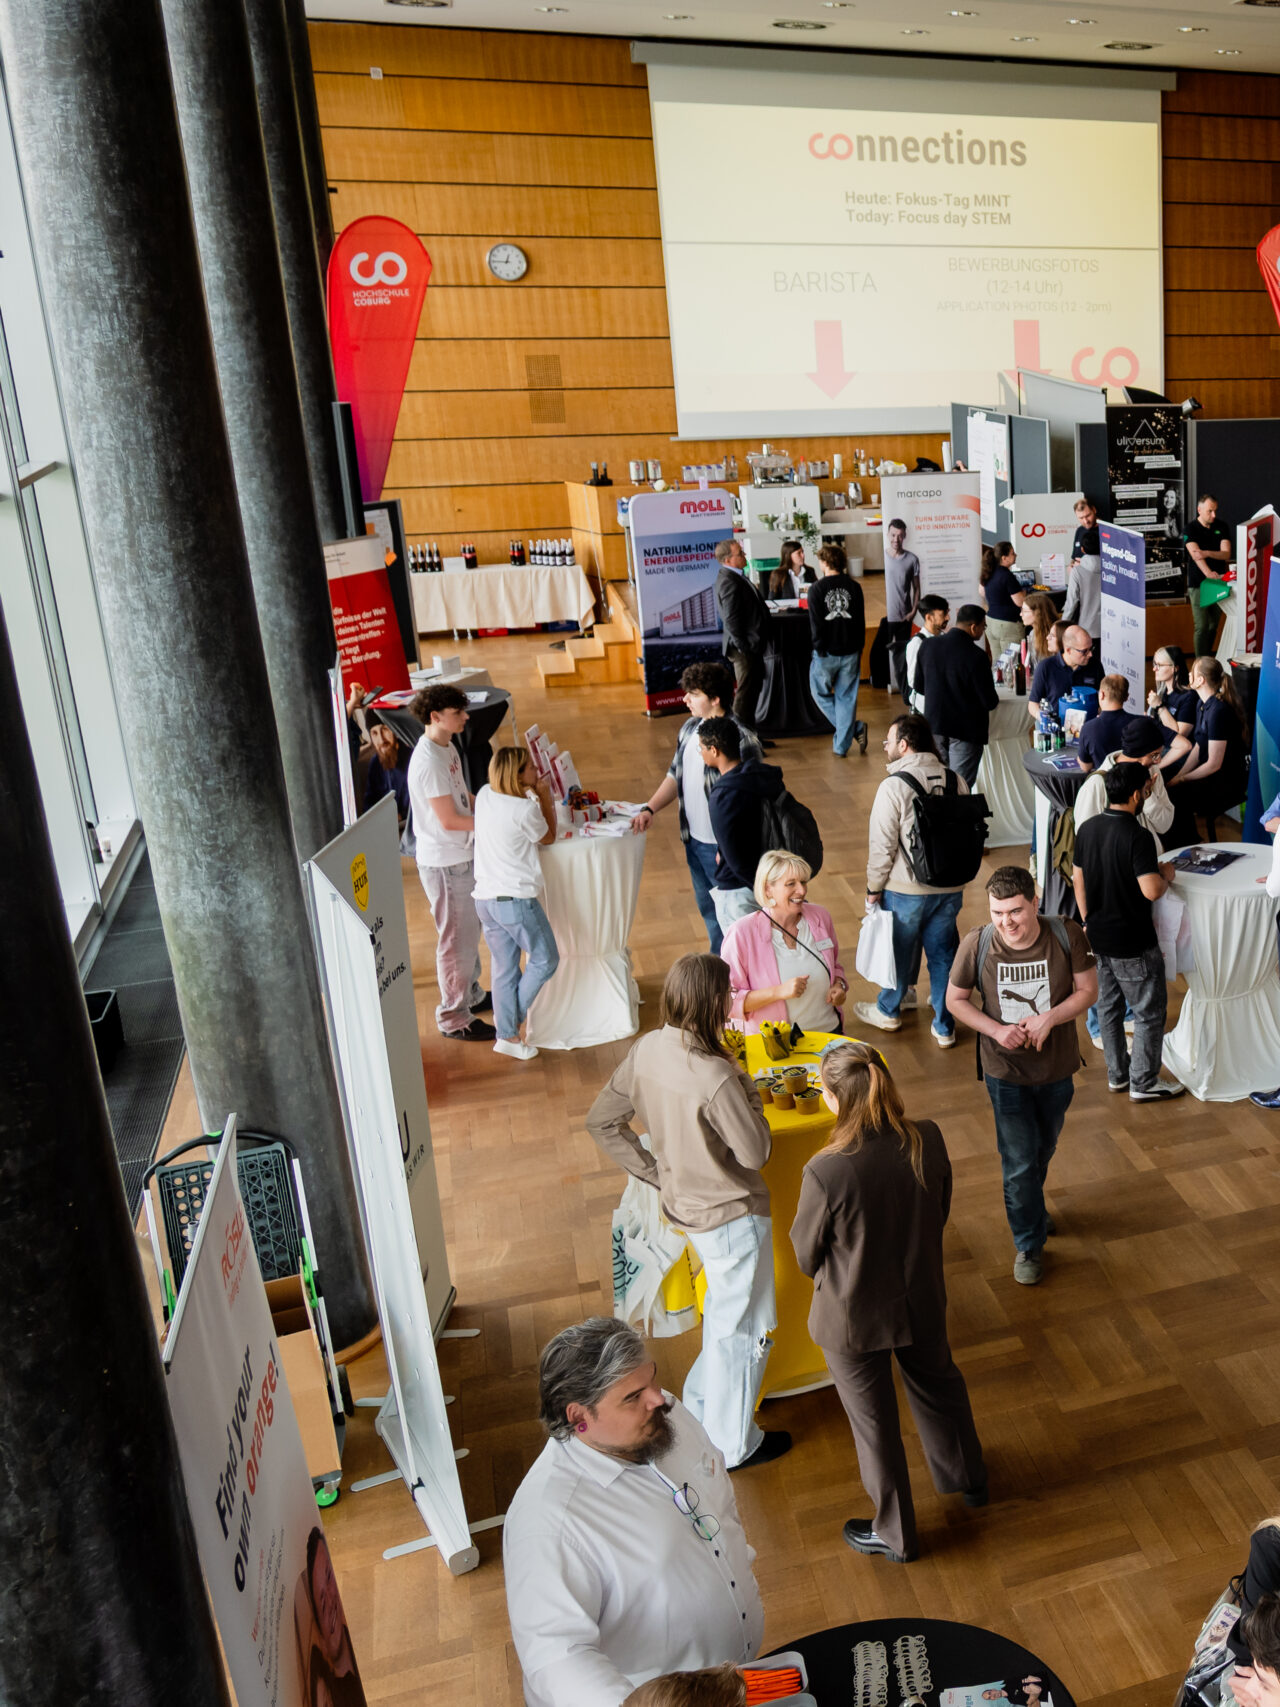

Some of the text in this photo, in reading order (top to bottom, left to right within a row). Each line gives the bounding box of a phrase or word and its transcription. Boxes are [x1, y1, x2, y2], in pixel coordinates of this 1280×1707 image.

[808, 129, 1028, 168] connections
[845, 191, 1011, 209] Heute: Fokus-Tag MINT
[846, 209, 1012, 228] Today: Focus day STEM
[948, 257, 1099, 273] BEWERBUNGSFOTOS
[773, 270, 878, 295] BARISTA
[986, 279, 1064, 296] (12-14 Uhr)
[353, 288, 409, 298] HOCHSCHULE
[354, 297, 391, 307] COBURG
[936, 300, 1010, 312] APPLICATION
[1012, 300, 1058, 312] PHOTOS
[896, 489, 942, 499] marcapo
[915, 514, 969, 523] TURN SOFTWARE
[933, 522, 971, 531] INNOVATION
[645, 562, 710, 577] MADE IN GERMANY
[361, 610, 373, 620] der
[372, 607, 387, 618] Welt
[359, 618, 386, 632] Talenten
[353, 871, 369, 894] HUK
[999, 962, 1046, 984] PUMA
[215, 1343, 254, 1542] Find your
[234, 1490, 253, 1593] own
[246, 1340, 279, 1496] orange!
